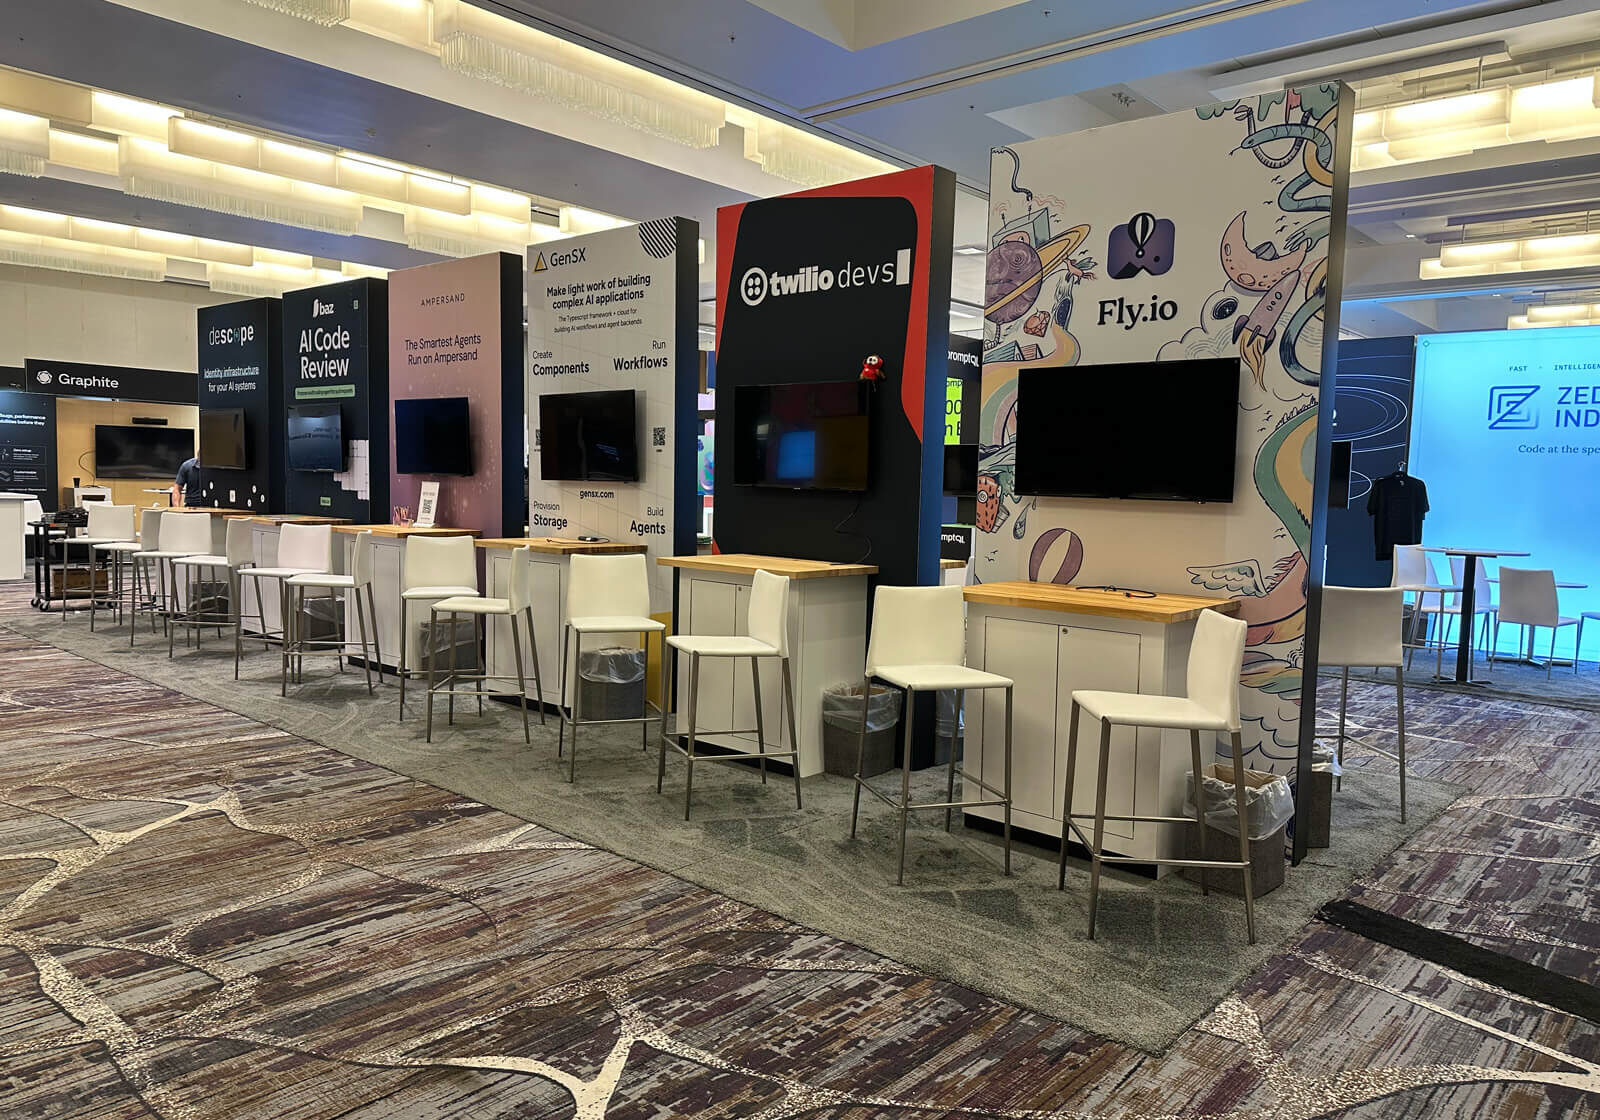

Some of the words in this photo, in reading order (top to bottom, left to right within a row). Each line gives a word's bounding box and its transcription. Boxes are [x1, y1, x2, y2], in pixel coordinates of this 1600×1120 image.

[550, 247, 586, 267] GenSX
[547, 286, 566, 297] Make
[567, 283, 584, 297] light
[587, 280, 606, 292] work
[607, 277, 617, 289] of
[618, 273, 651, 287] building
[769, 265, 835, 297] twilio
[837, 261, 895, 289] devs
[420, 292, 465, 306] AMPERSAND
[552, 296, 584, 310] complex
[585, 294, 594, 305] AI
[595, 288, 645, 306] applications
[319, 302, 335, 316] baz
[1097, 294, 1178, 331] Fly.io
[599, 321, 607, 329] and
[607, 320, 620, 329] agent
[299, 328, 312, 353] AI
[314, 325, 350, 351] Code
[405, 339, 418, 351] The
[419, 336, 453, 350] Smartest
[454, 333, 482, 349] Agents
[652, 340, 666, 350] Run
[408, 353, 421, 366] Run
[423, 354, 432, 364] on
[434, 347, 478, 366] Ampersand
[532, 350, 553, 360] Create
[301, 352, 350, 379] Review
[533, 361, 590, 377] Components
[613, 356, 668, 371] Workflows
[58, 373, 119, 389] Graphite
[208, 382, 216, 392] for
[216, 383, 228, 394] your
[228, 380, 234, 391] AI
[234, 380, 257, 393] systems
[1518, 444, 1545, 454] Code
[1547, 445, 1559, 454] at
[1561, 444, 1579, 454] the
[1581, 446, 1600, 455] spe
[580, 489, 614, 499] gensx.com
[534, 501, 560, 511] Provision
[647, 506, 664, 517] Build
[534, 513, 568, 530] Storage
[630, 520, 666, 536] Agents
